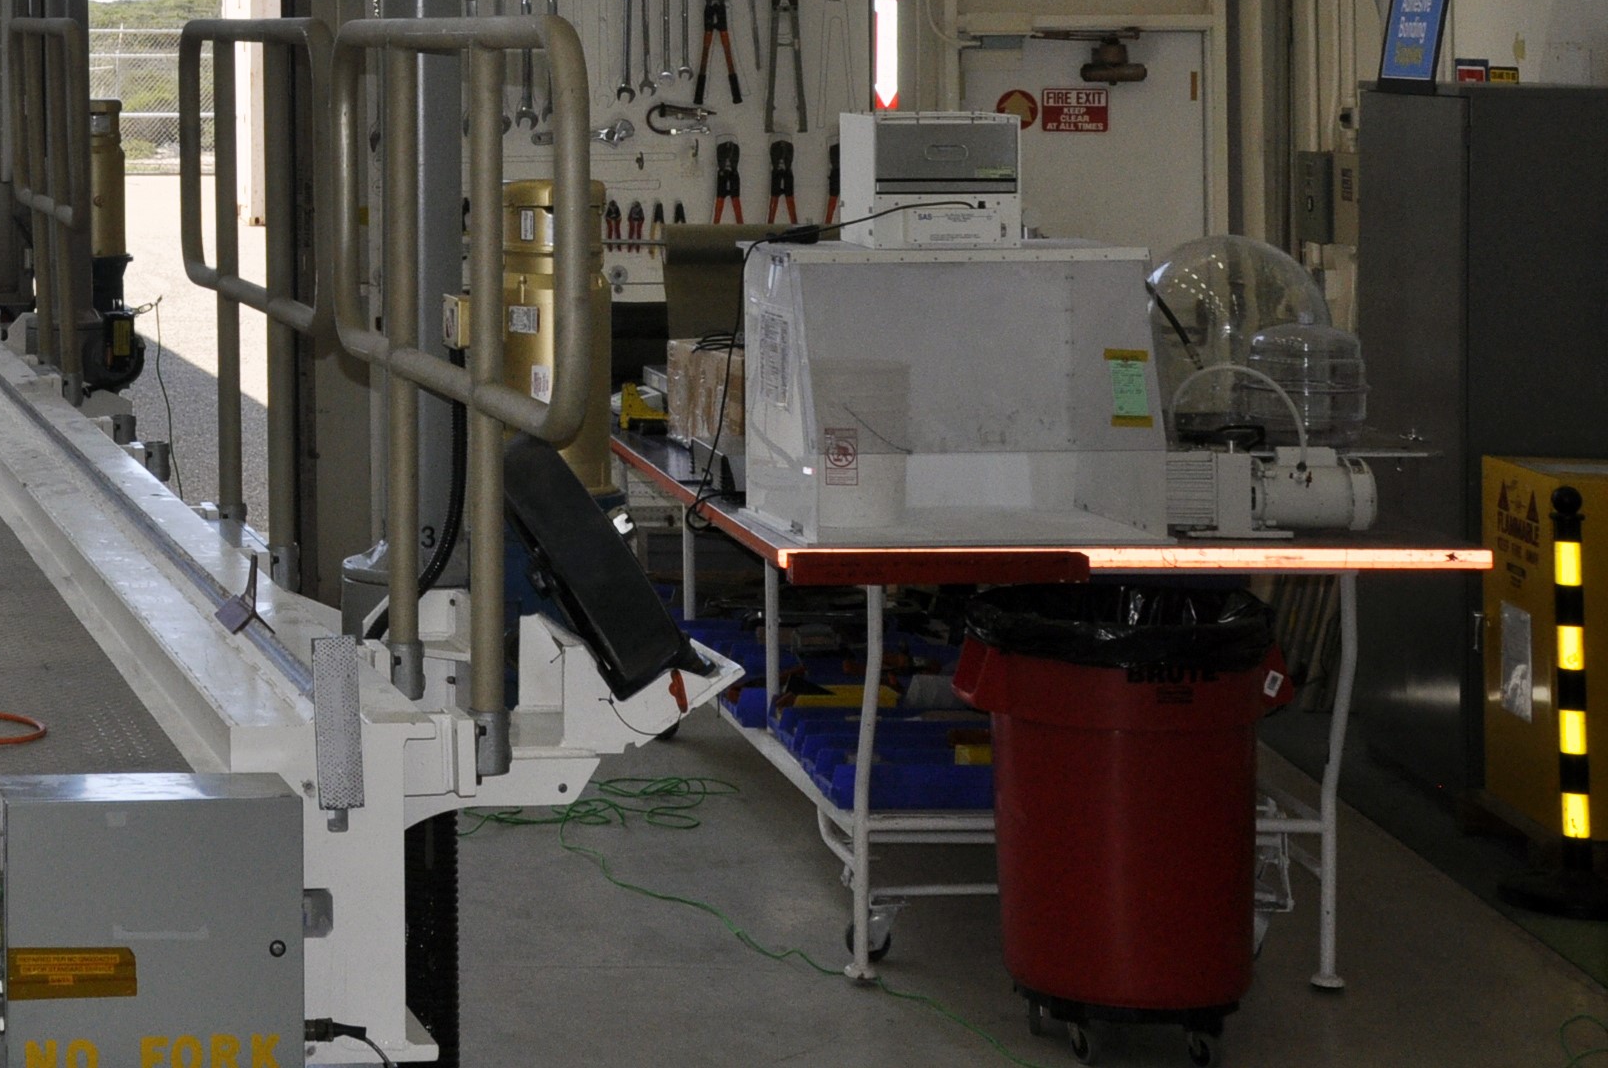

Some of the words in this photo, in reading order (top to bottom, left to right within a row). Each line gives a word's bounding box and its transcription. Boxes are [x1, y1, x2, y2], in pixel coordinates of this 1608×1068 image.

[1397, 15, 1428, 44] Bonding
[1045, 91, 1072, 105] FIRE
[1076, 91, 1104, 105] EXIT
[1046, 122, 1058, 130] AT
[1059, 122, 1076, 130] ALL
[1078, 122, 1104, 130] TIMES
[1059, 114, 1090, 122] CLEAR
[421, 525, 435, 549] 3
[1497, 511, 1540, 548] FLAMMABLE
[1127, 664, 1220, 684] BRUTE
[25, 1039, 98, 1068] NO
[140, 1033, 281, 1068] FORK
